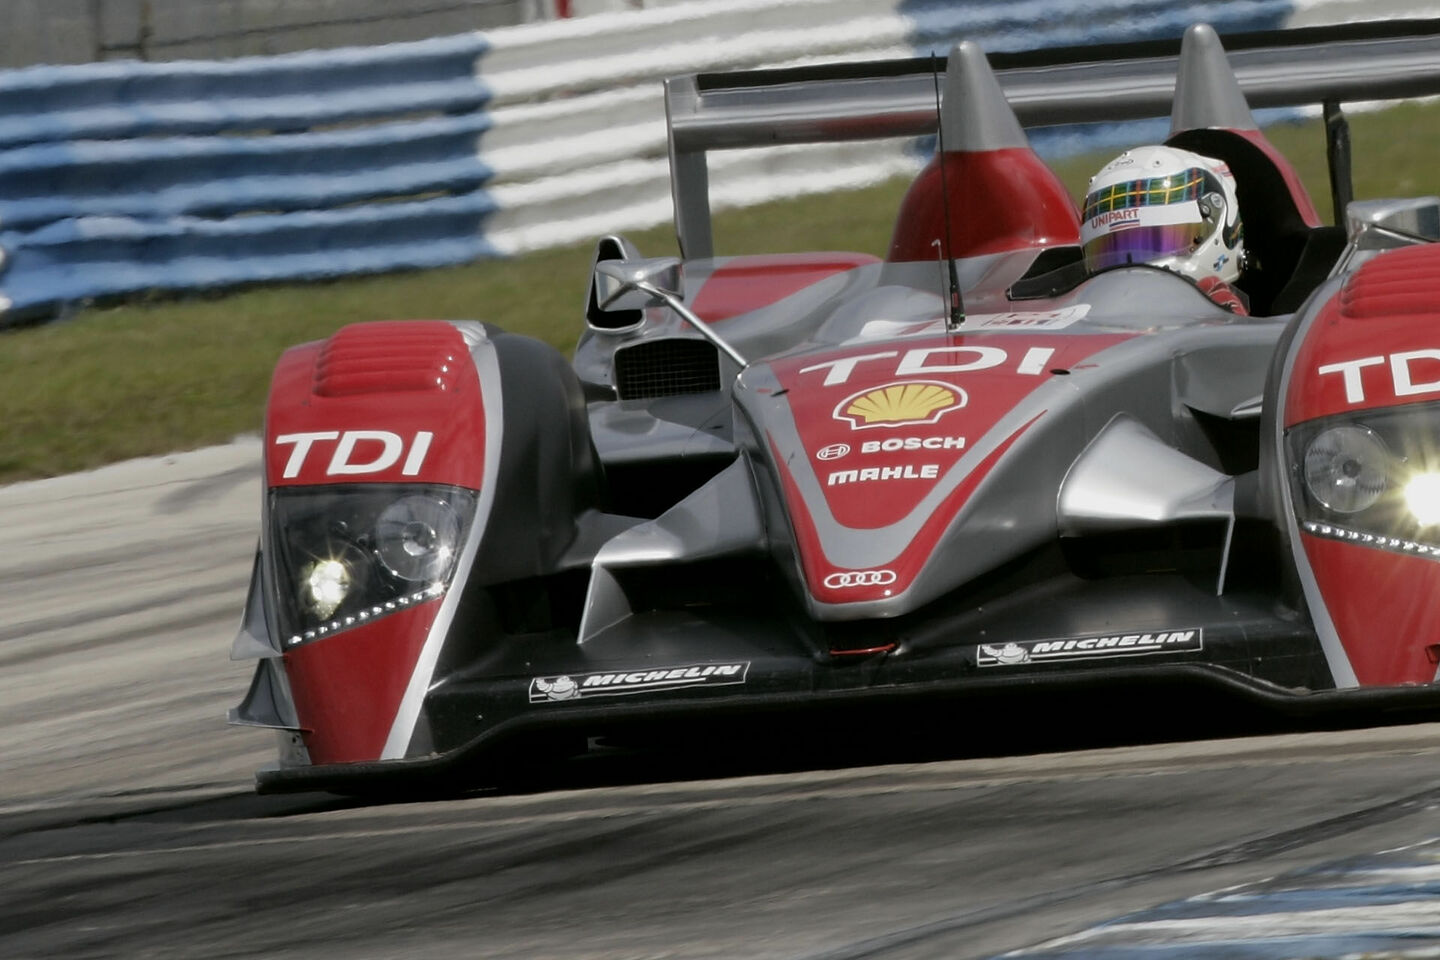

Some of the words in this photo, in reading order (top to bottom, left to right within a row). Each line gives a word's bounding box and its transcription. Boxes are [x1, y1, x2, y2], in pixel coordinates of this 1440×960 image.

[1091, 208, 1140, 229] UNIPART
[799, 346, 1056, 386] TDI
[275, 430, 434, 479] TDI
[861, 437, 966, 454] BOSCH
[828, 464, 940, 487] MAHLE
[1032, 630, 1194, 653] MICHELIN
[582, 664, 742, 687] MICHELIN
